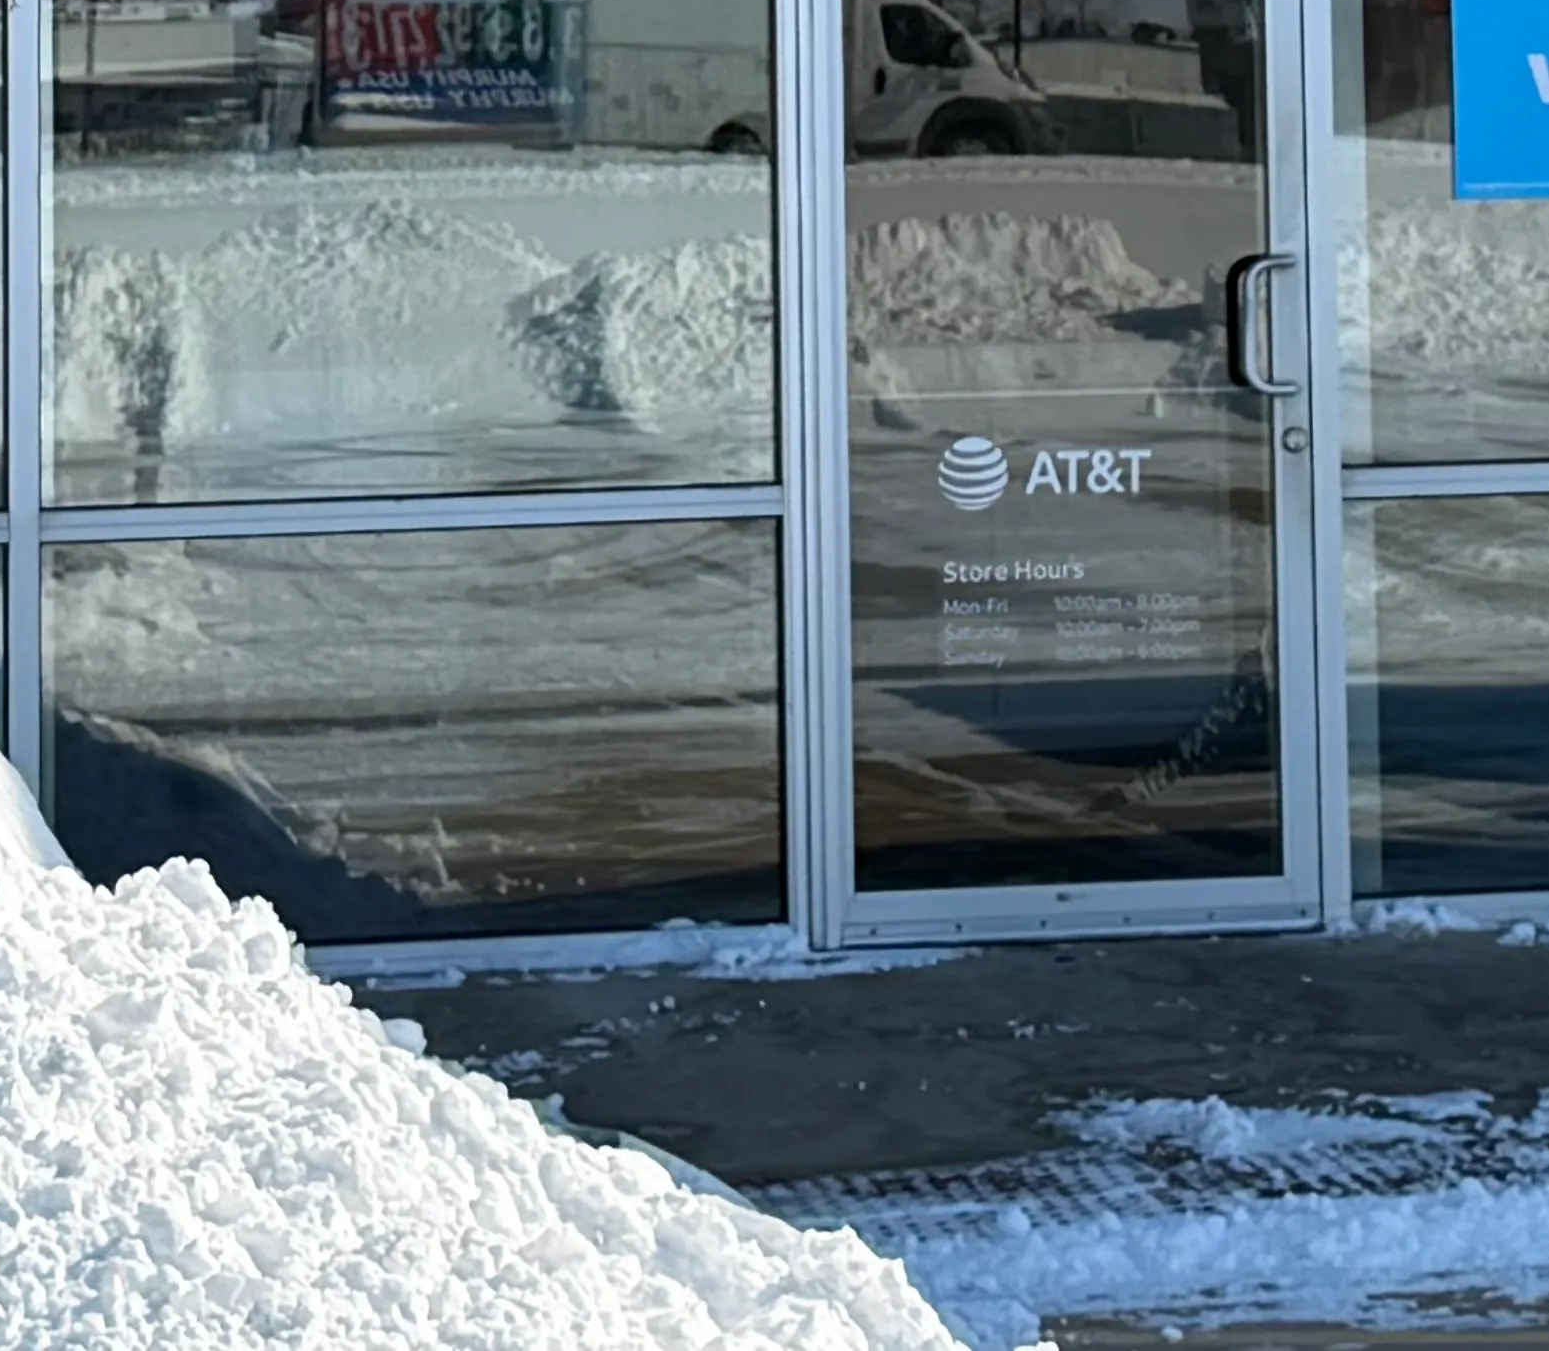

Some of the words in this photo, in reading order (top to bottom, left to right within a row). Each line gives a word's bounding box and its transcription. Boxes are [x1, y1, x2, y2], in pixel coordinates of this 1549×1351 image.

[1026, 449, 1151, 494] AT&T
[943, 561, 1008, 583] Store
[1015, 559, 1085, 581] Hours
